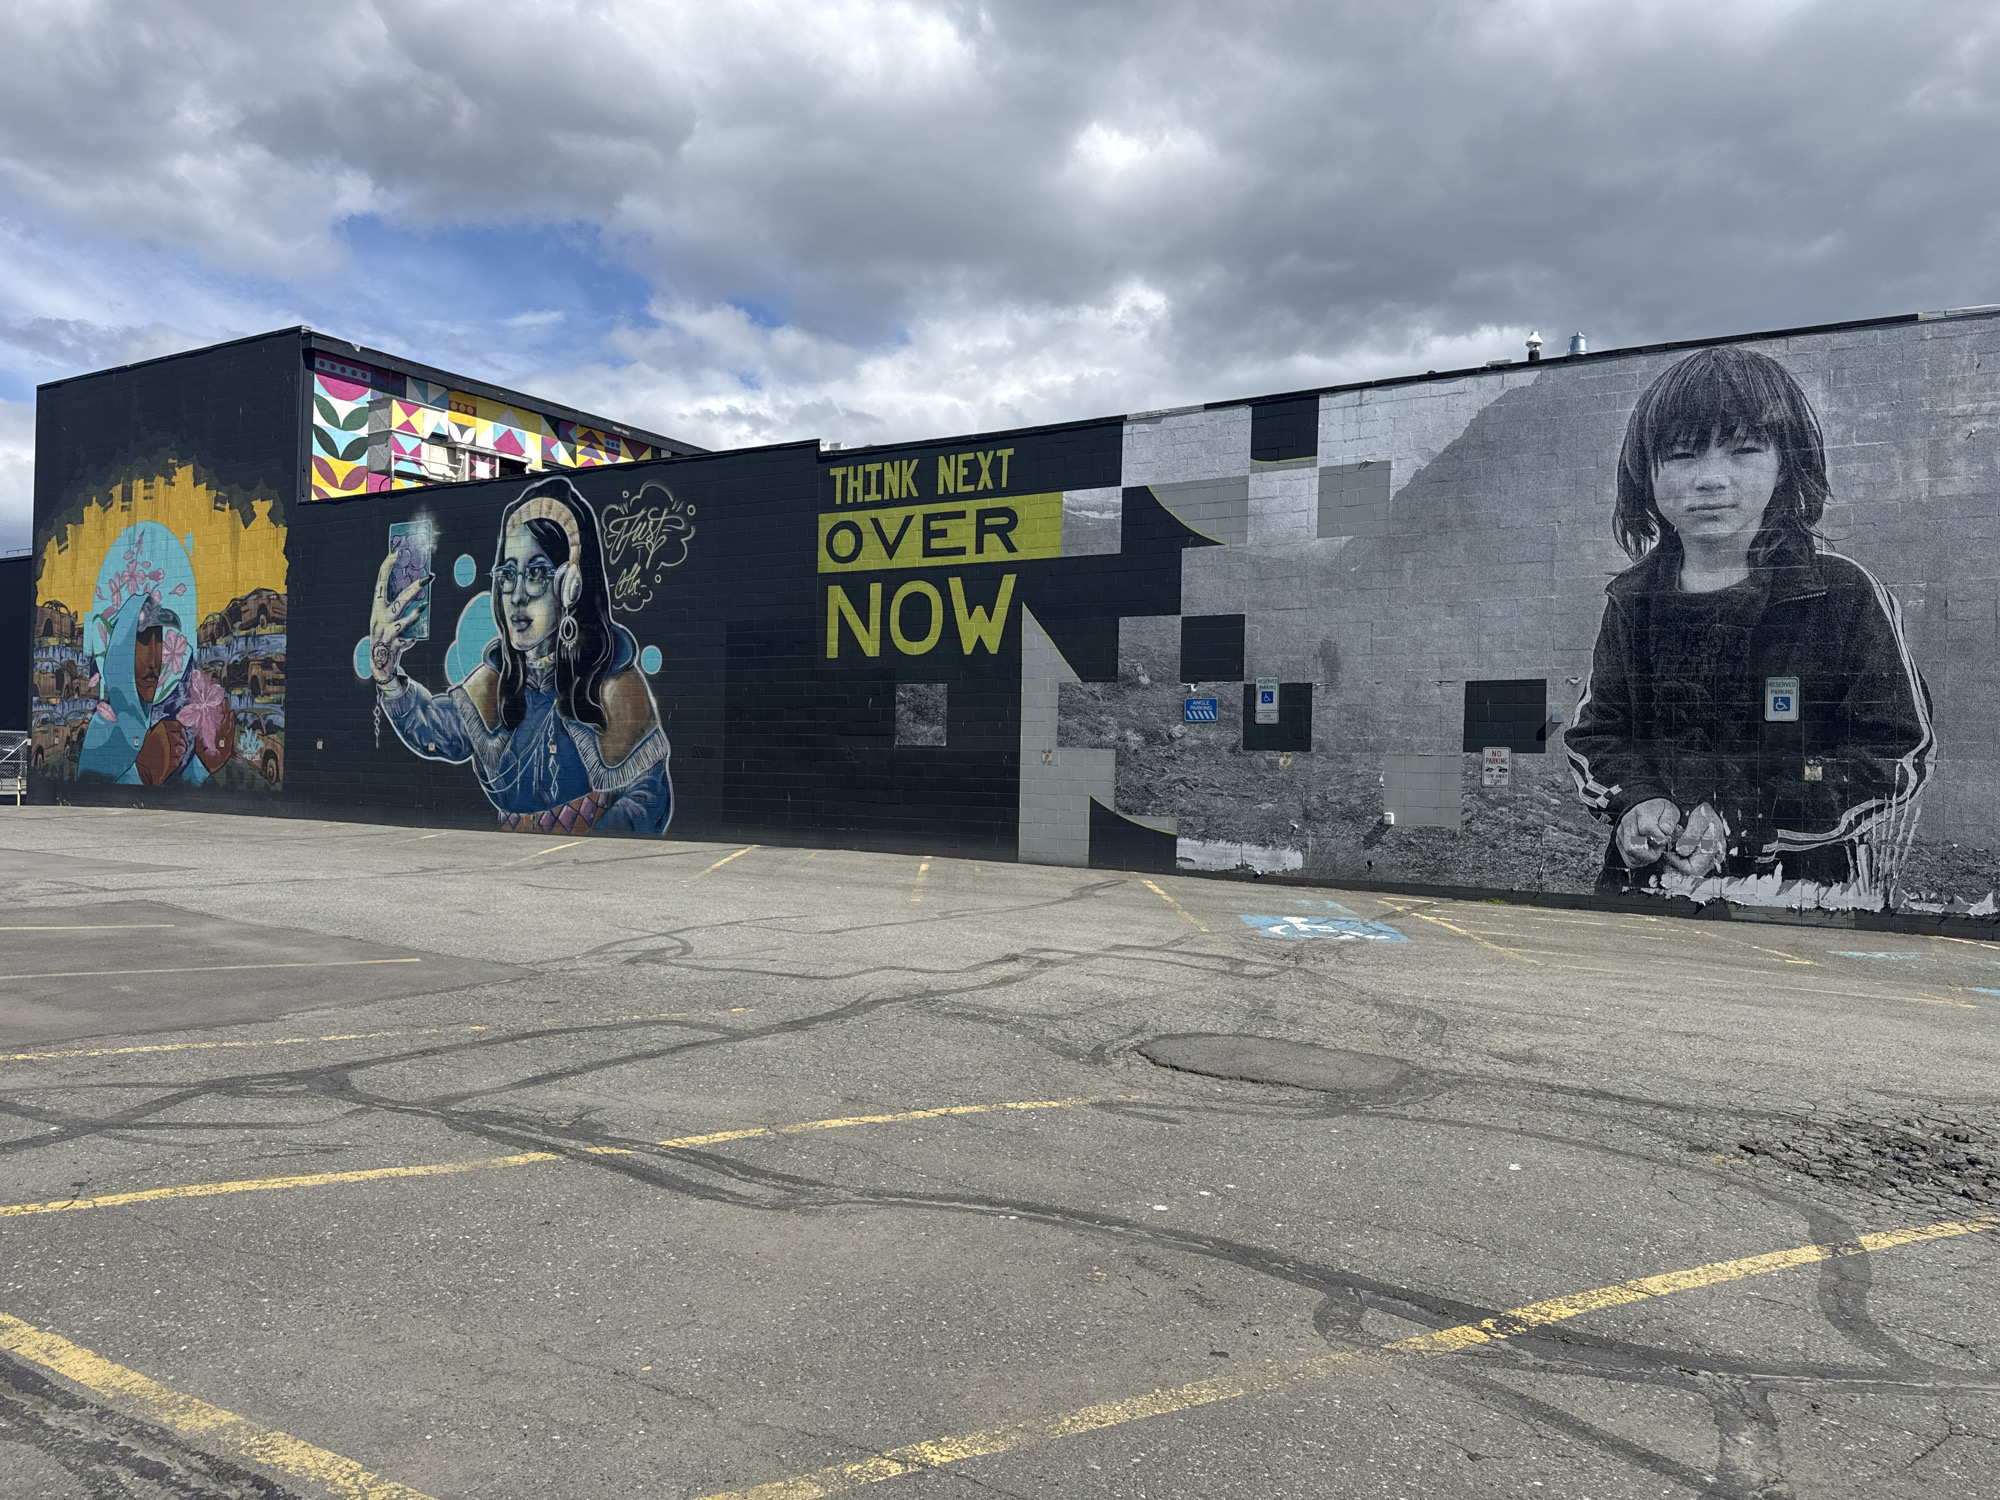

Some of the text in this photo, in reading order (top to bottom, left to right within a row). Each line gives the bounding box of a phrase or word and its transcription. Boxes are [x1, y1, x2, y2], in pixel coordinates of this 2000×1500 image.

[829, 447, 1015, 505] THINK NEXT
[825, 506, 1019, 565] OVER
[826, 573, 1018, 659] NOW
[1485, 757, 1508, 765] PARKING
